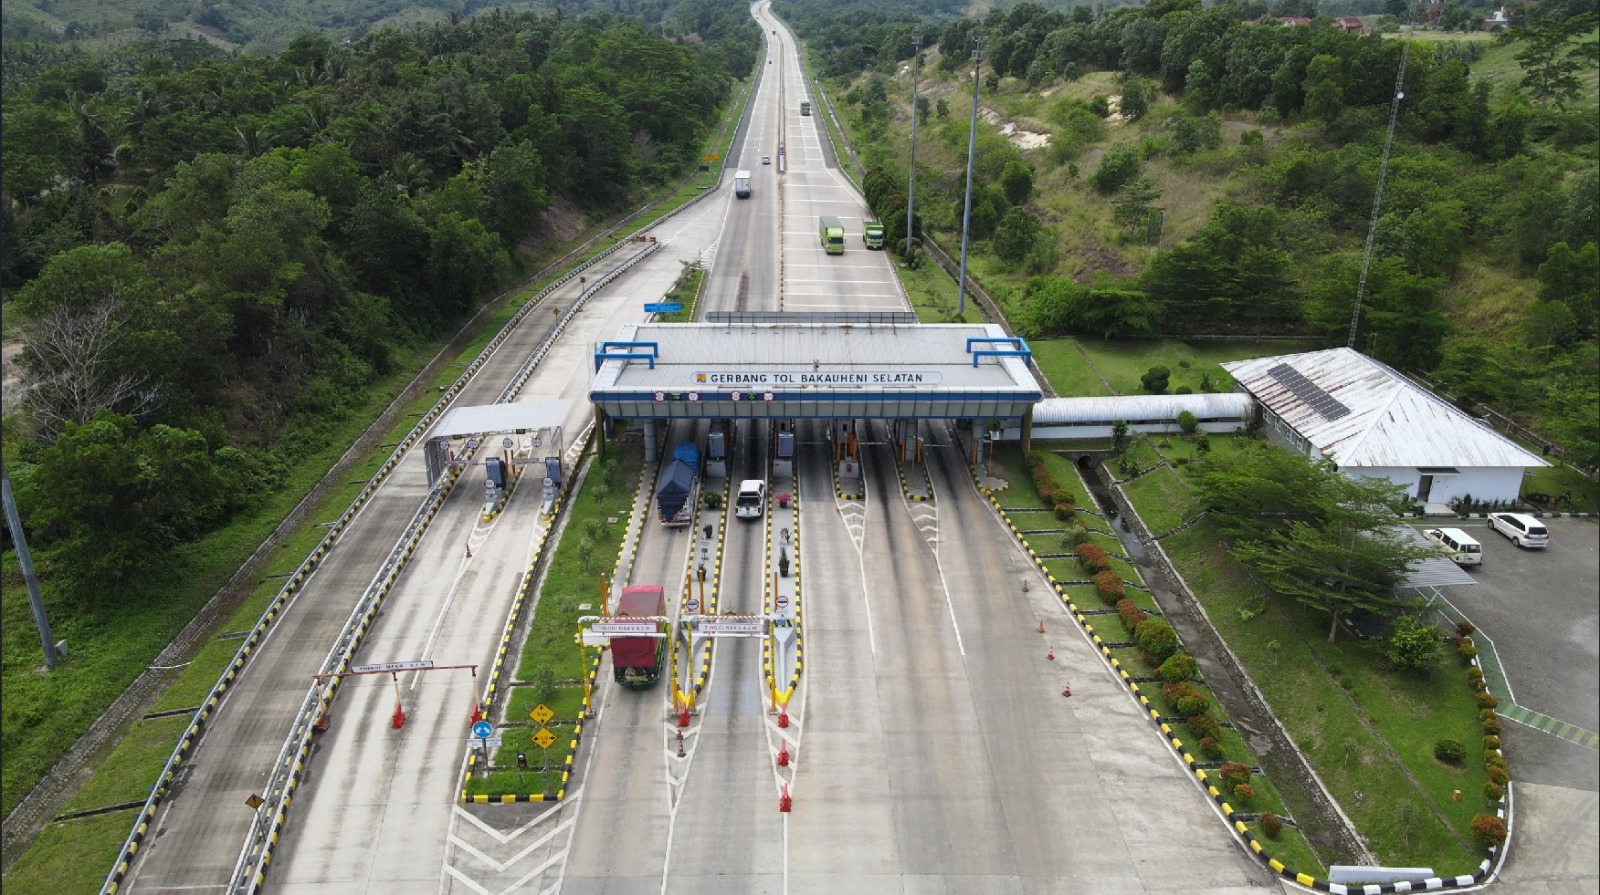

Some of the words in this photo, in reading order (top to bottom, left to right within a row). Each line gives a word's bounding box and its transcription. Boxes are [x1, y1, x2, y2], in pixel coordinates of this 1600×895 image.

[710, 374, 767, 383] GERBANG
[773, 374, 796, 383] TOL
[801, 374, 868, 383] BAKAUHENI
[873, 373, 923, 383] SELATAN
